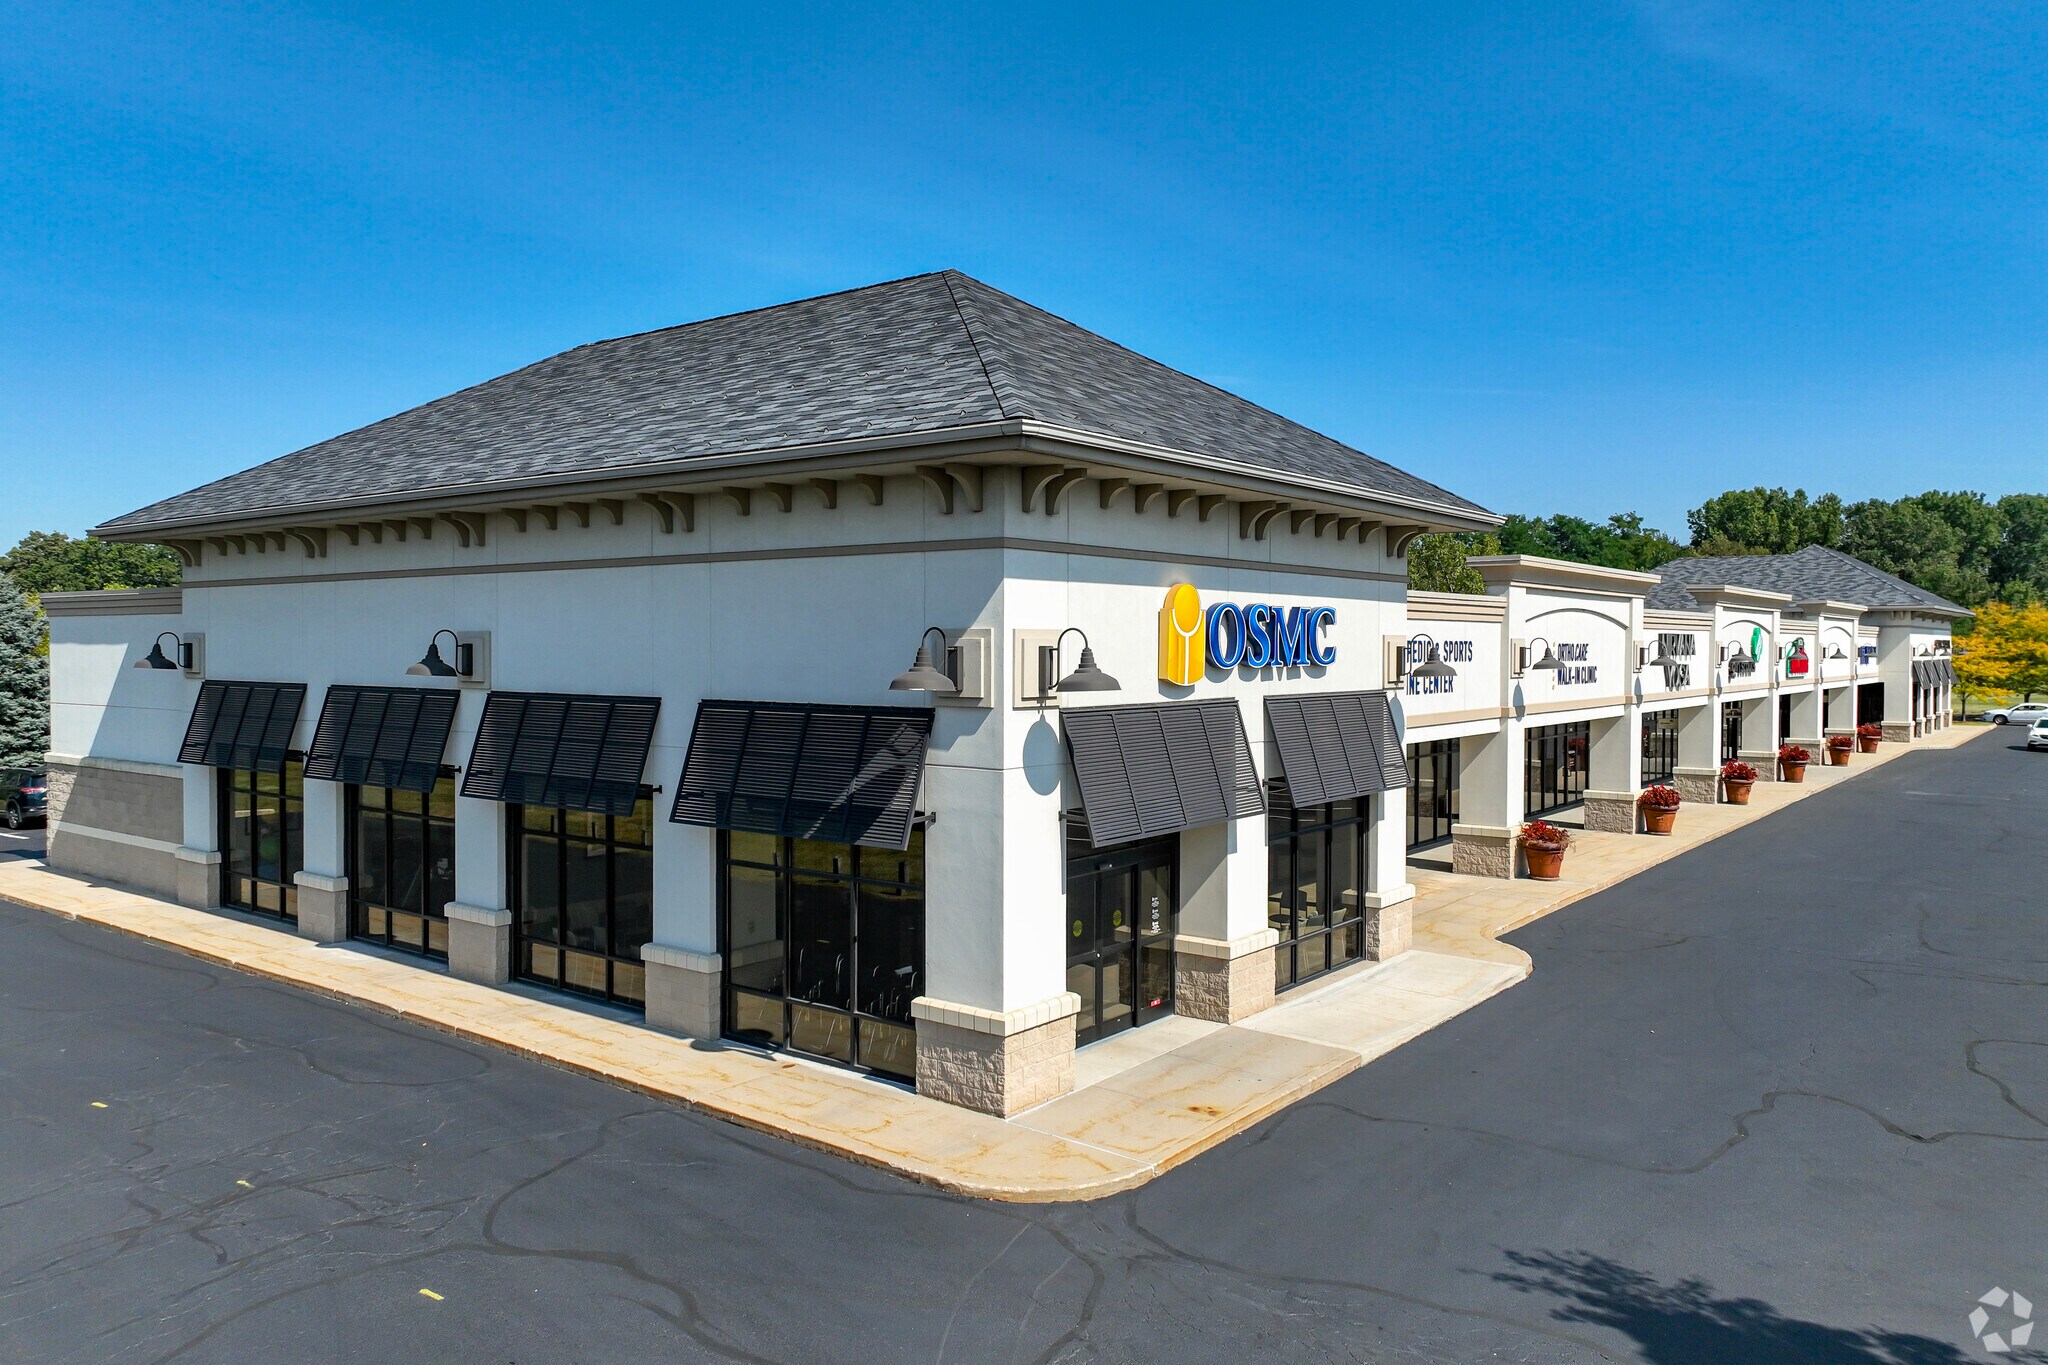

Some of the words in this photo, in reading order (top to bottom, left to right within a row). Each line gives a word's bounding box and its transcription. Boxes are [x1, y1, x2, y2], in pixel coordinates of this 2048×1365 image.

[1205, 602, 1337, 670] OSMC
[1443, 640, 1473, 663] SPORTS
[1557, 643, 1575, 662] ORTHO
[1575, 643, 1589, 662] CARE
[1422, 674, 1454, 695] CENTER
[1581, 665, 1598, 685] CLINIC
[1664, 664, 1690, 687] YOGA
